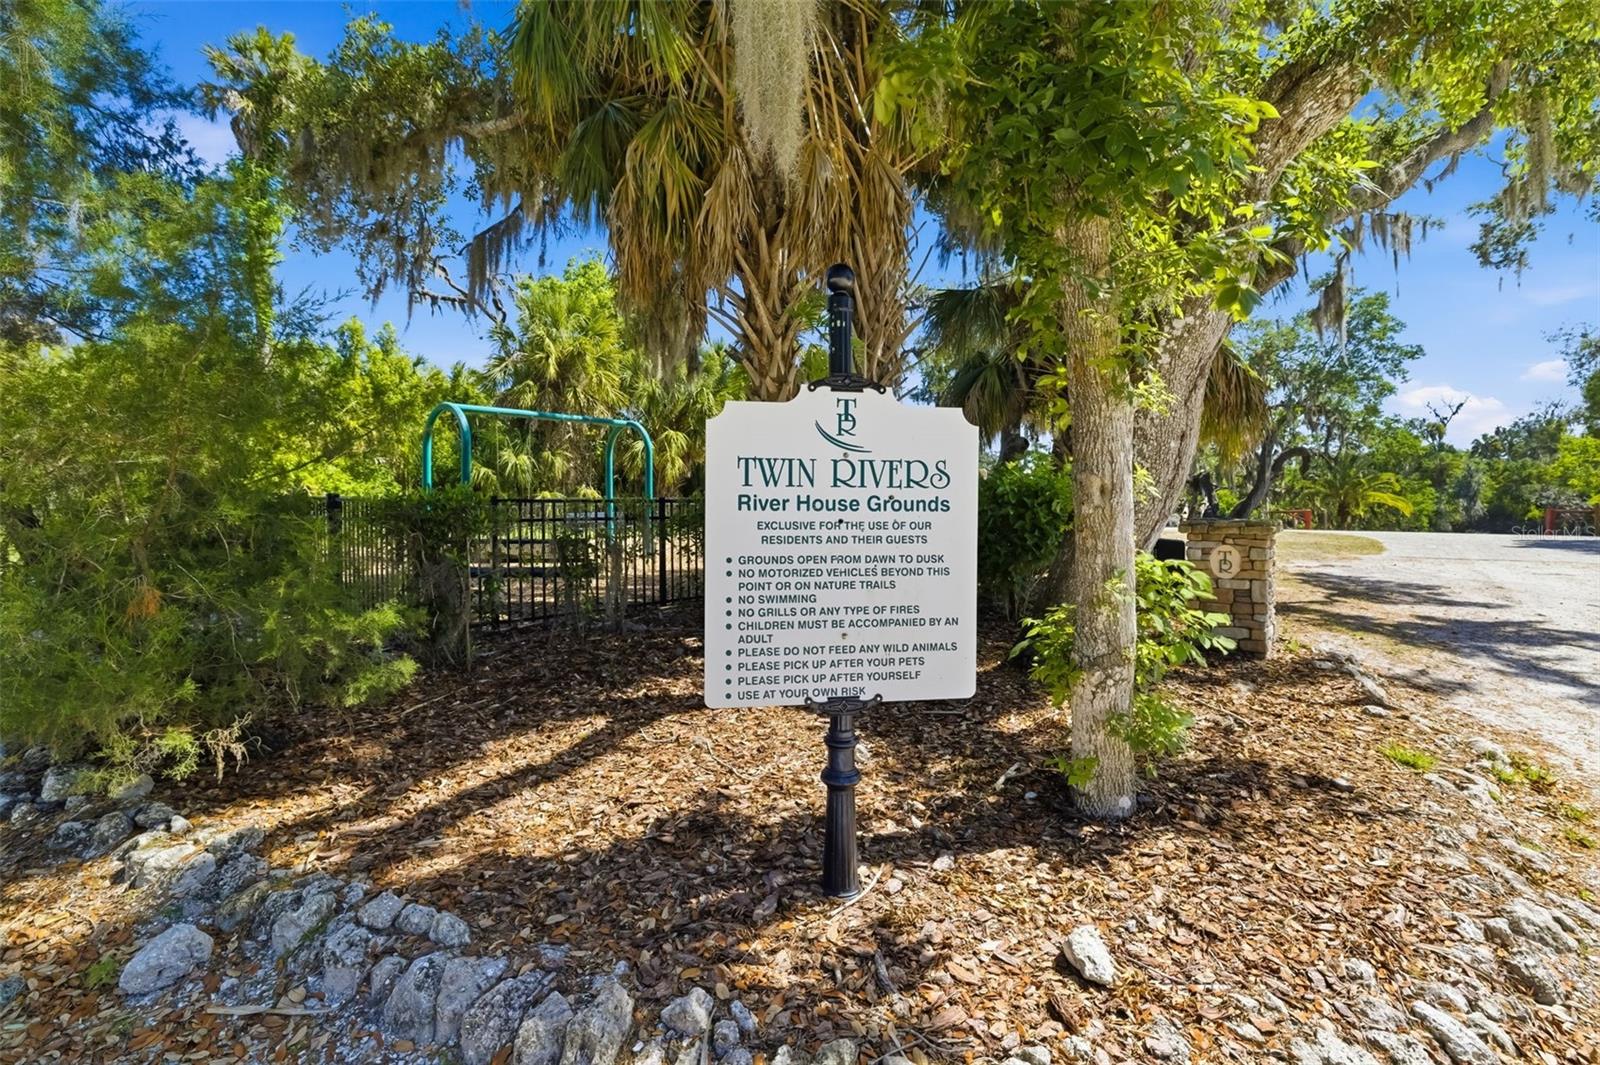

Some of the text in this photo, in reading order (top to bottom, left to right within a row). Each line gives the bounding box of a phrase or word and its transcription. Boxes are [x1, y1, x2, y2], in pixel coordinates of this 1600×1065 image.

[737, 455, 951, 490] TWIN RIVERS
[737, 494, 951, 512] River House Grounds
[757, 521, 932, 531] EXCLUSIVE FOR THE USE OF OUR
[761, 534, 928, 545] RESIDENTS AND THEIR GUESTS
[738, 554, 945, 565] GROUNDS OPEN FROM DAWN TO DUSK
[738, 567, 951, 578] NO MOTORIZED VEHICLES BEYOND THIS
[738, 580, 896, 592] POINT OR ON NATURE TRAILS
[738, 594, 817, 605] NO SWIMMING
[738, 605, 920, 618] NO GRILLS OR ANY TYPE OF FIRES
[738, 617, 959, 631] CHILDREN MUST BE ACCOMPANIED BY AN
[737, 634, 774, 644] ADULT
[738, 642, 958, 658] PLEASE DO NOT FEED ANY WILD ANIMALS
[738, 656, 925, 672] PLEASE PICK UP AFTER YOUR PETS
[738, 671, 922, 686] PLEASE PICK UP AFTER YOURSELF
[737, 687, 866, 701] USE AT YOUR OWN RISK
